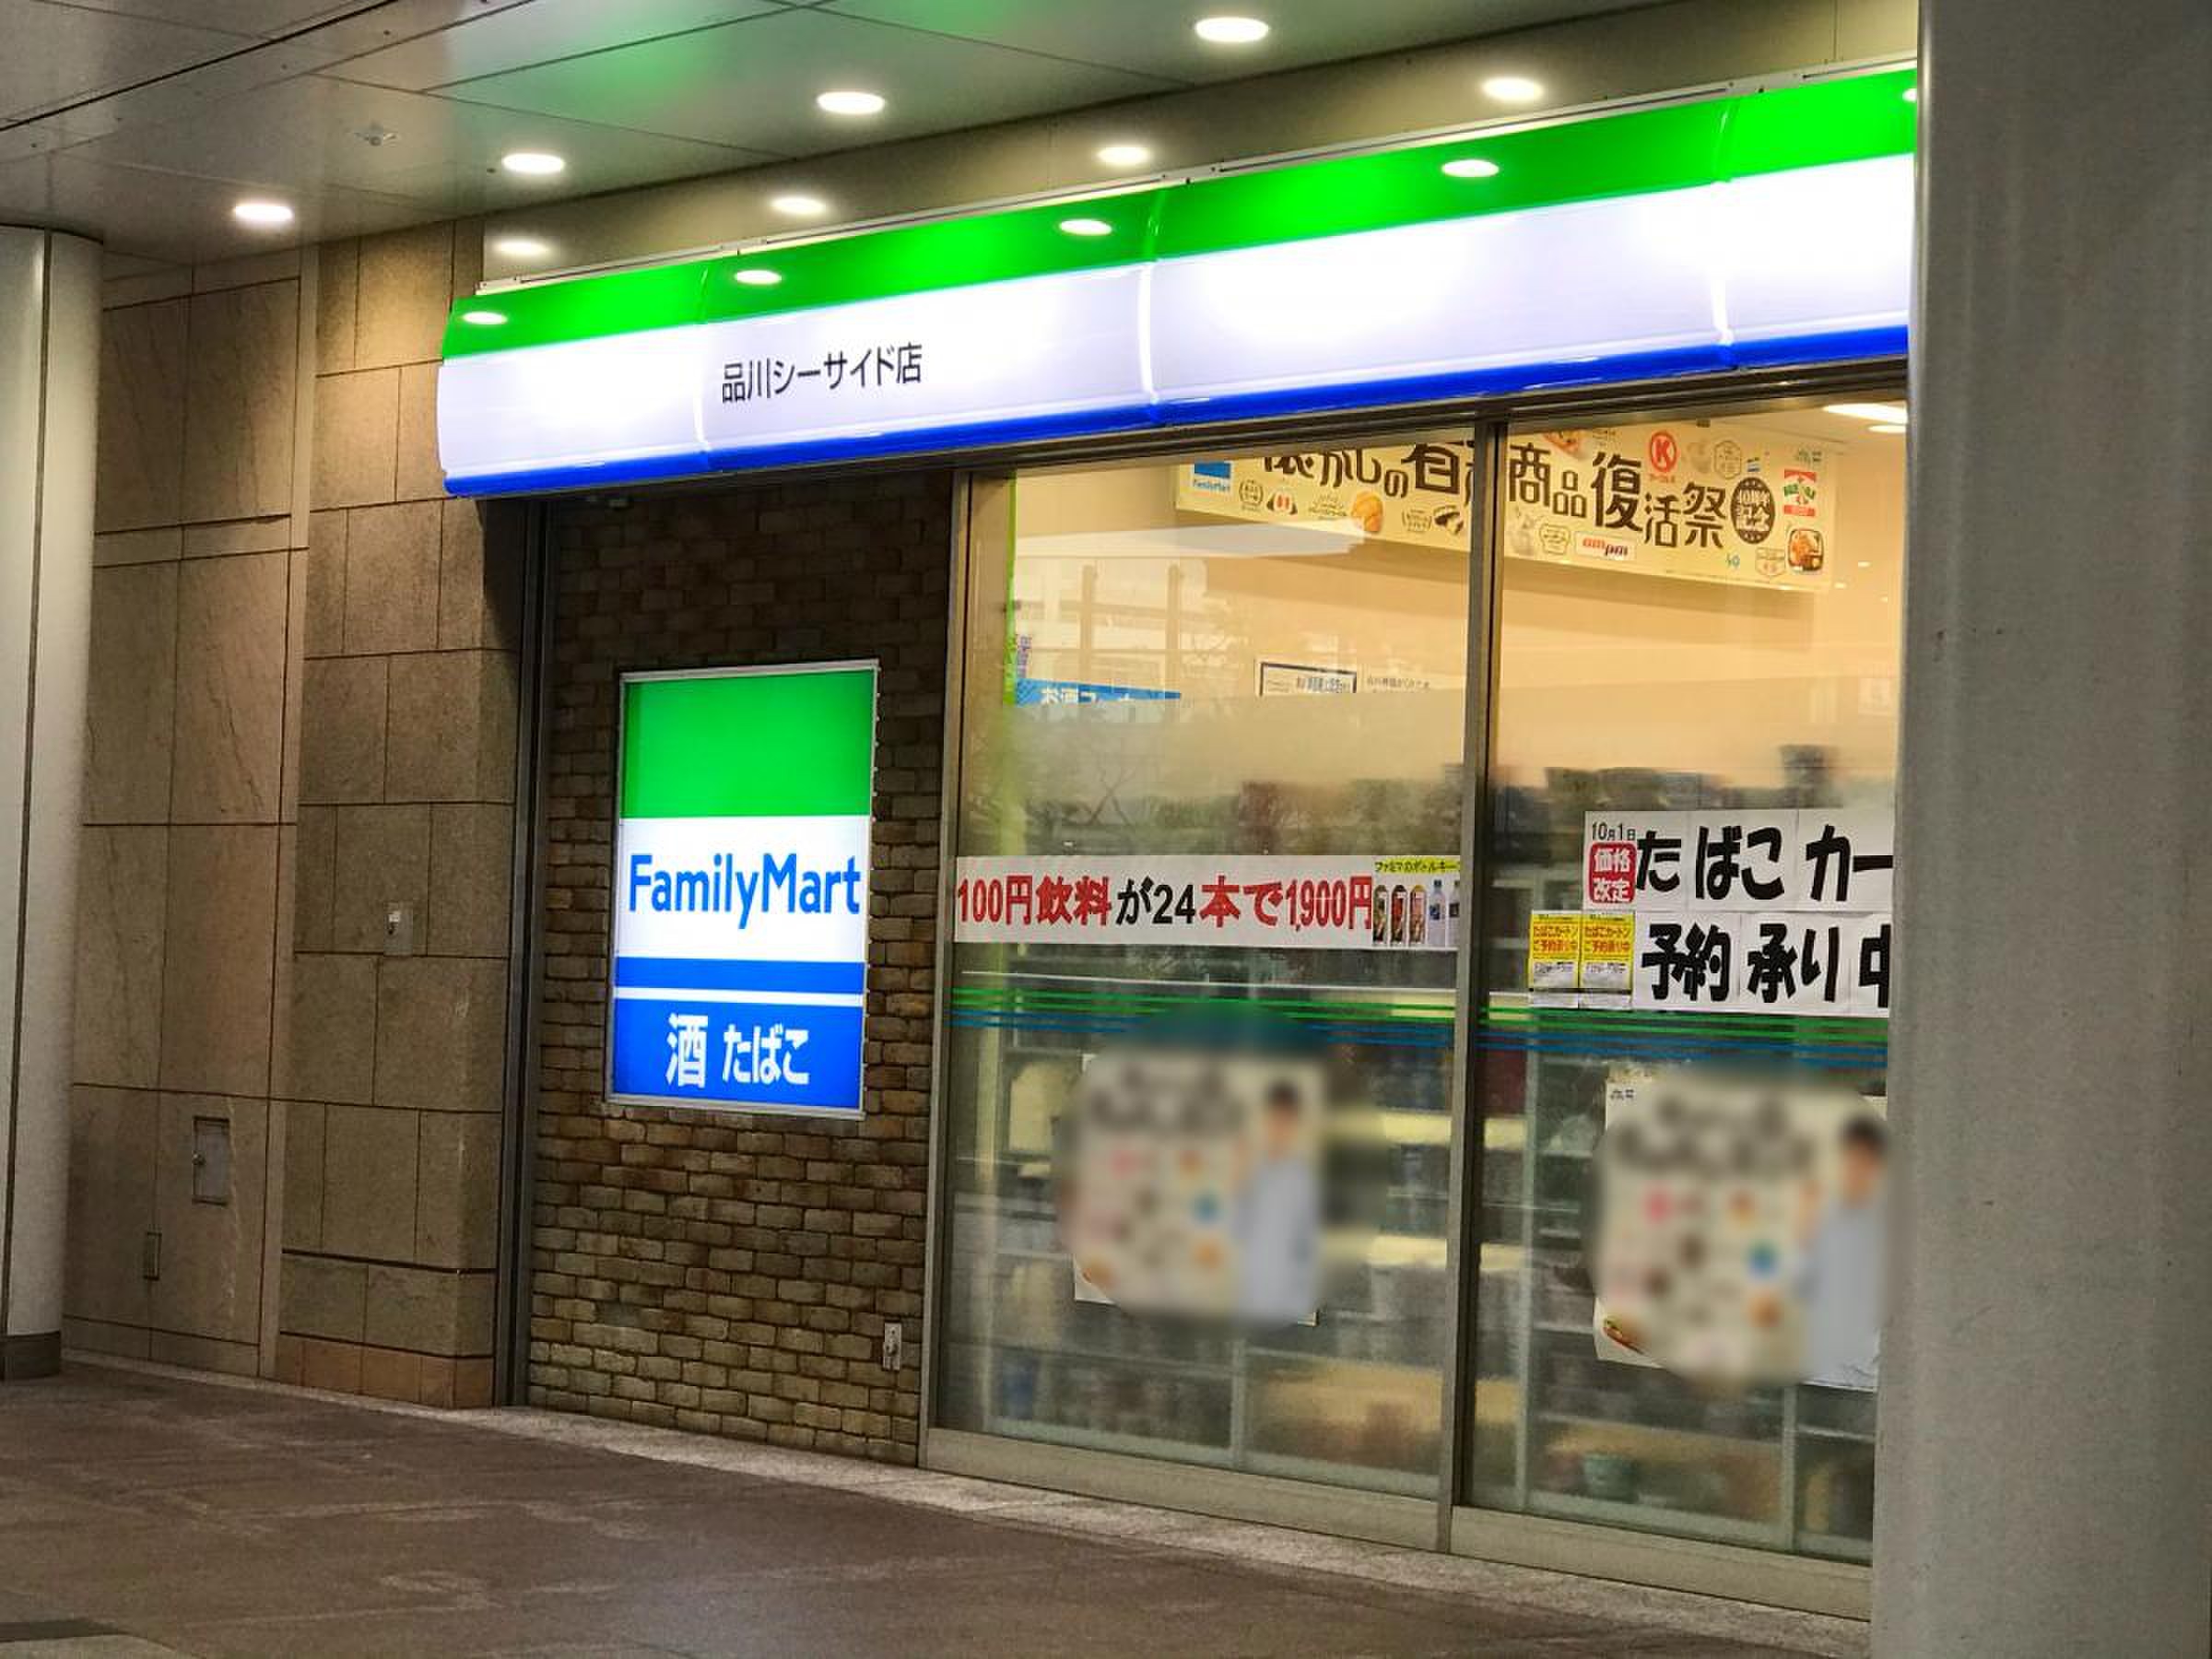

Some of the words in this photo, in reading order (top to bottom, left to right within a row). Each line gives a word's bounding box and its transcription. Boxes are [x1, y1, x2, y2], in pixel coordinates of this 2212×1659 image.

[722, 342, 923, 403] 品川シーサイド店
[1592, 822, 1636, 841] 10月1日
[1594, 848, 1630, 873] 価格
[629, 853, 861, 930] FamilyMart
[957, 874, 1372, 933] 100円飲料が24本で1,900円
[1593, 877, 1630, 902] 改定
[665, 1013, 709, 1088] 酒
[722, 1023, 810, 1086] たばこ
